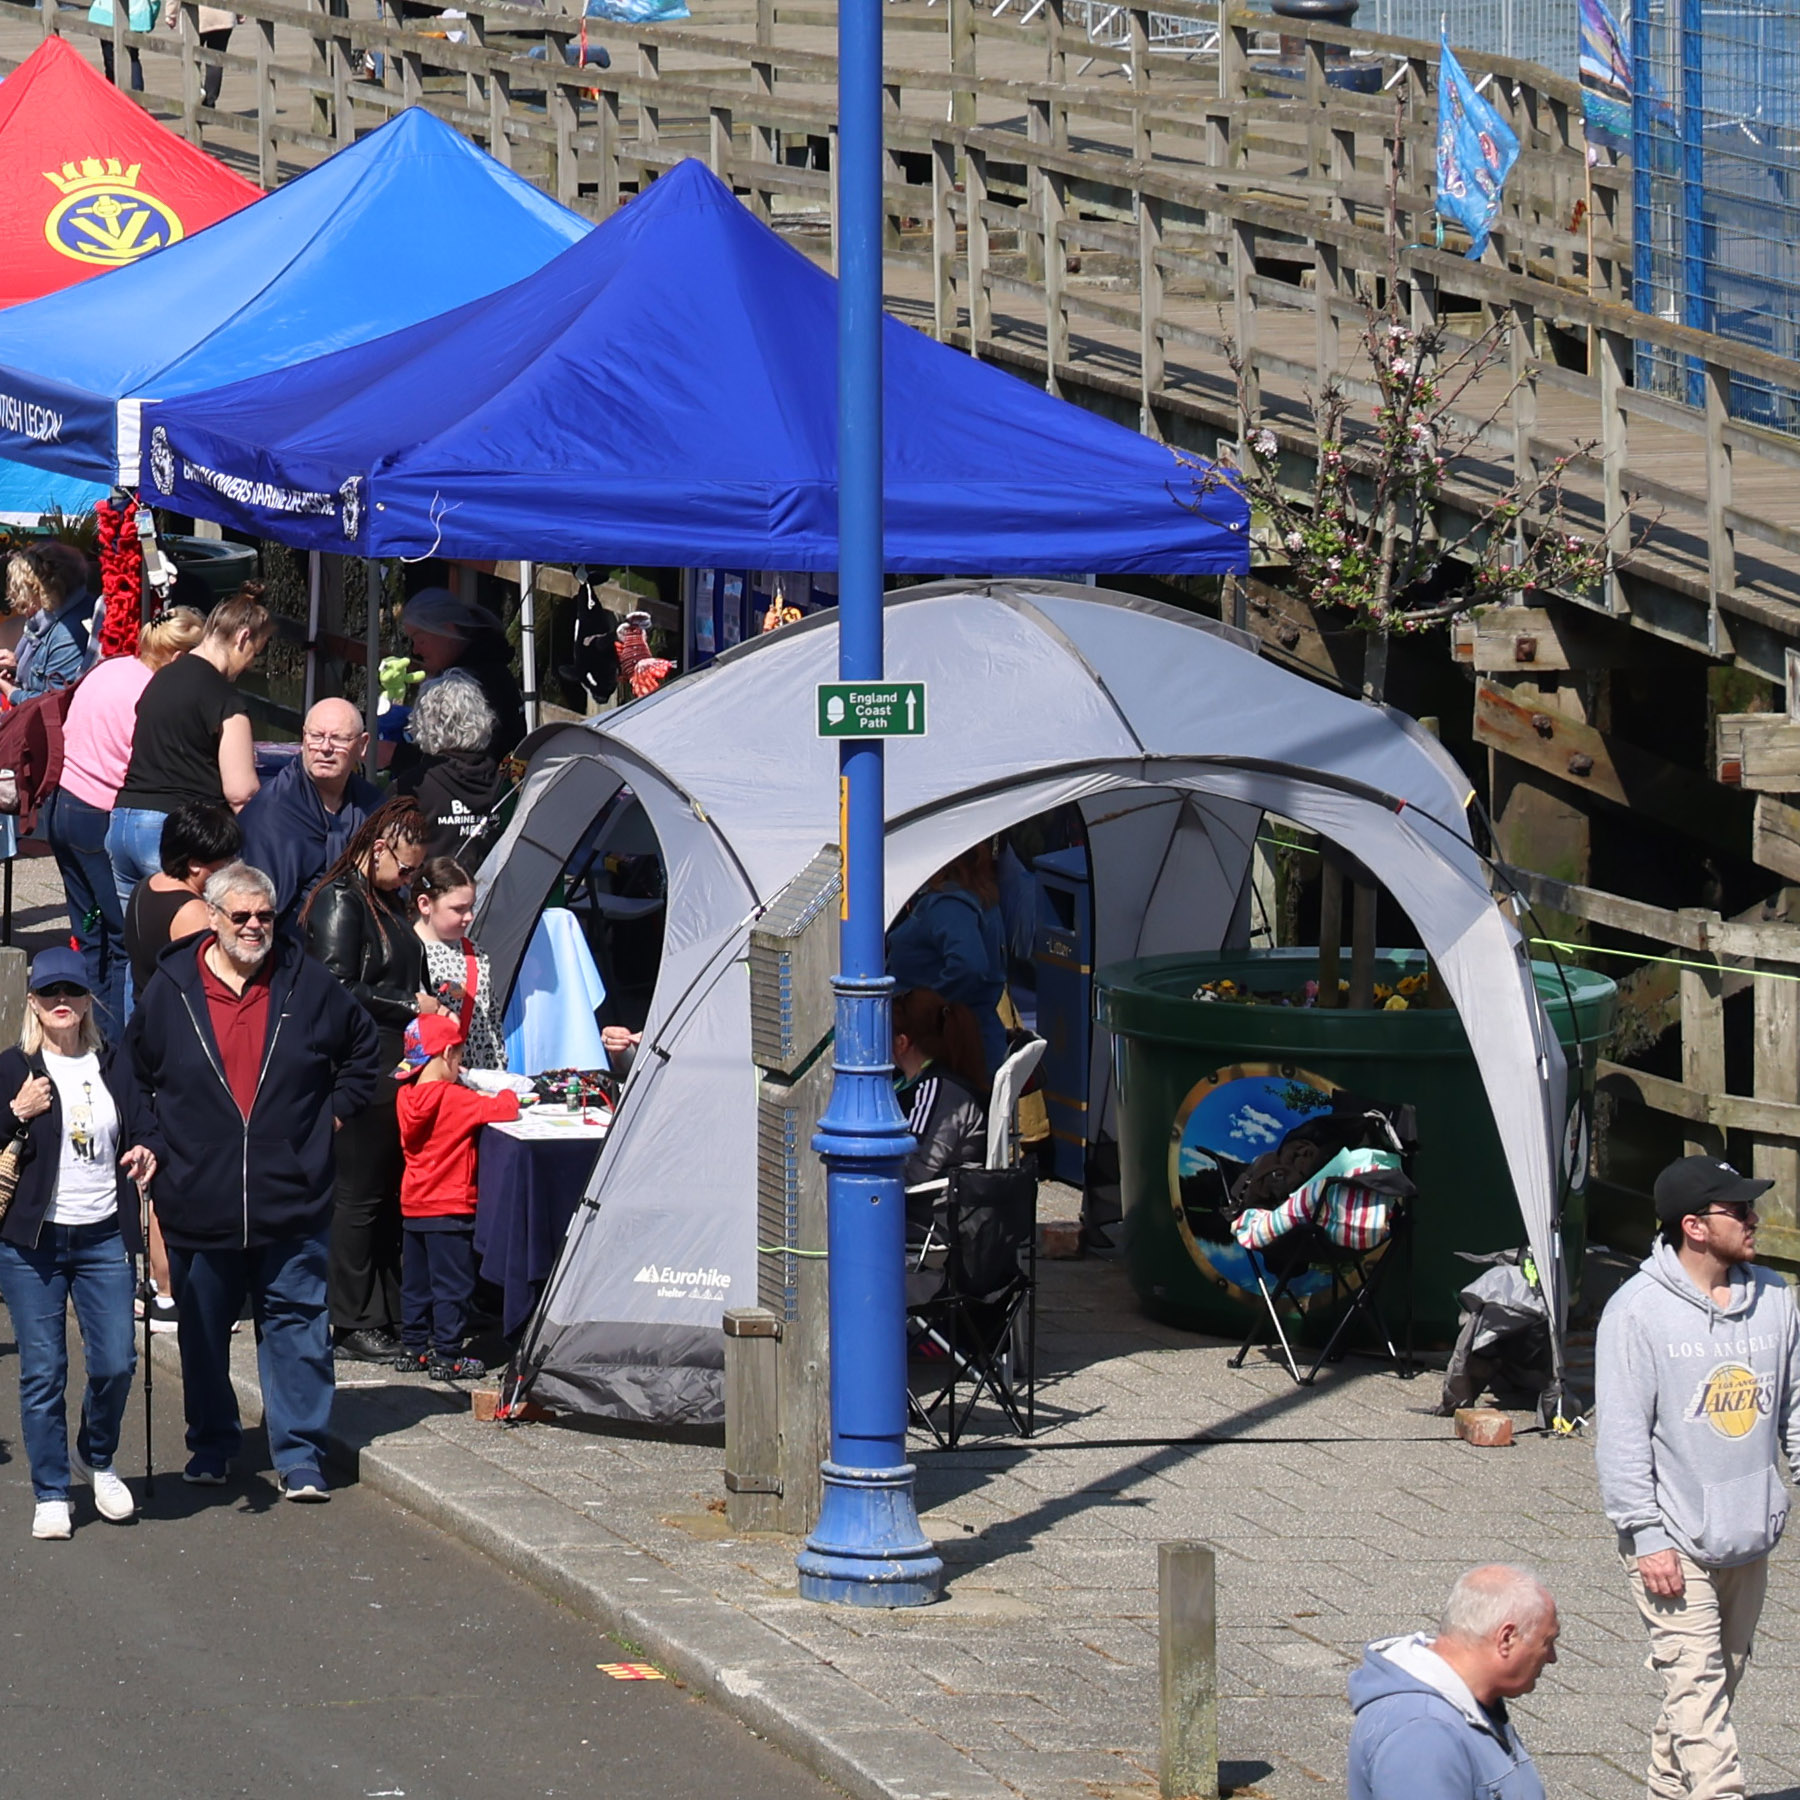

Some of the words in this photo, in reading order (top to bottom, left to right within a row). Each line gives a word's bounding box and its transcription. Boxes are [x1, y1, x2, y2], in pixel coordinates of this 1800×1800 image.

[24, 402, 63, 444] LEGION
[849, 692, 898, 706] England
[855, 705, 892, 716] Coast
[860, 718, 888, 729] Path
[437, 815, 476, 826] MARINE
[660, 1267, 732, 1288] Eurohike
[657, 1287, 687, 1298] shelter
[1668, 1342, 1705, 1359] LOS
[1718, 1380, 1734, 1390] LOS
[1694, 1382, 1776, 1420] LAKERS
